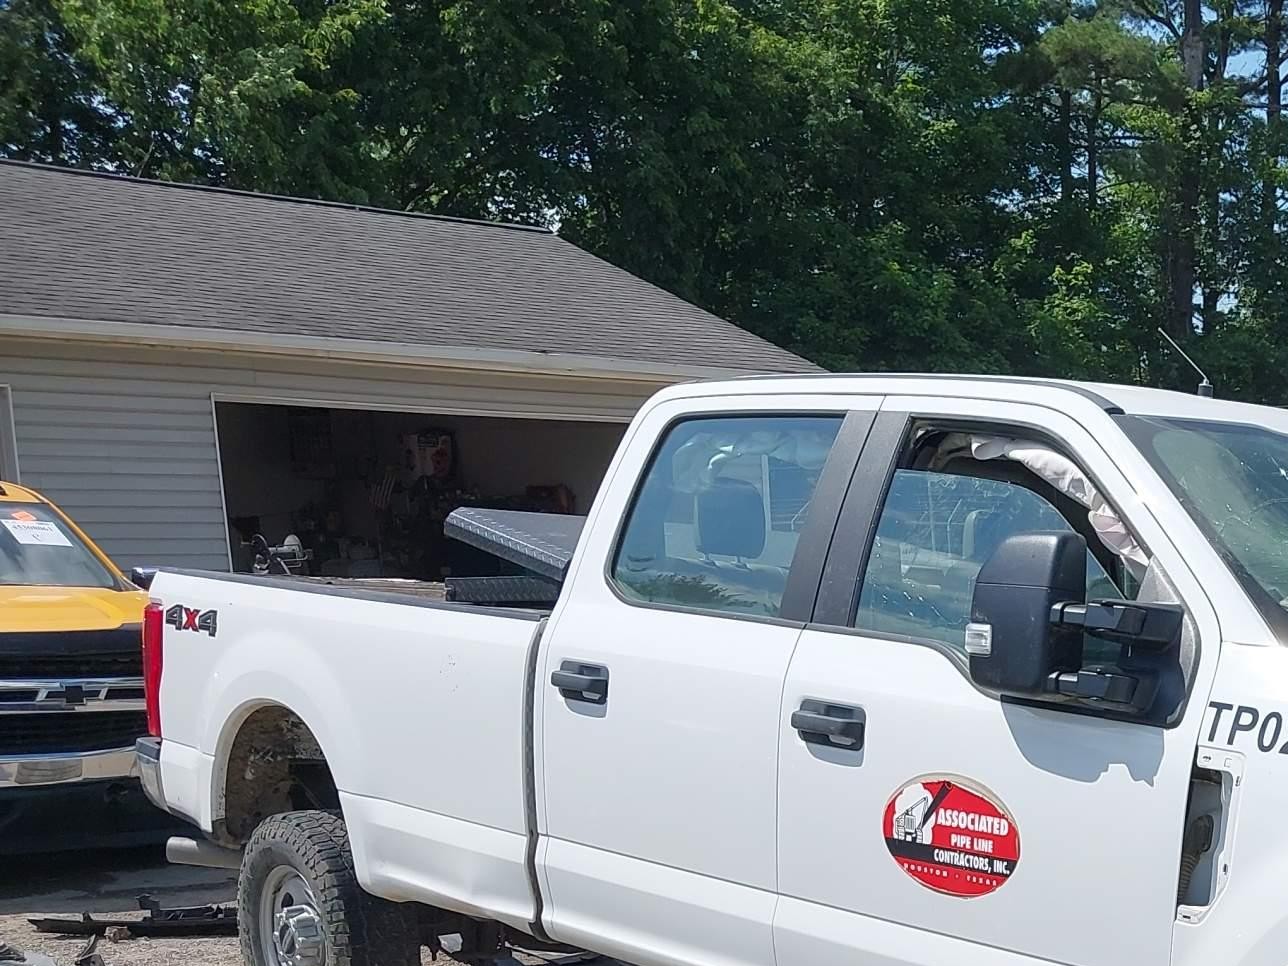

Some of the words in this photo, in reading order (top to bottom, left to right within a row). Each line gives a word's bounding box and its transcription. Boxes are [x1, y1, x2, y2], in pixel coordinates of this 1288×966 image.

[936, 808, 1009, 836] ASSOCIATED
[950, 833, 971, 849] PIPE
[974, 837, 994, 853] LINE
[933, 848, 992, 873] CONTRACTORS,
[993, 860, 1010, 875] INC.
